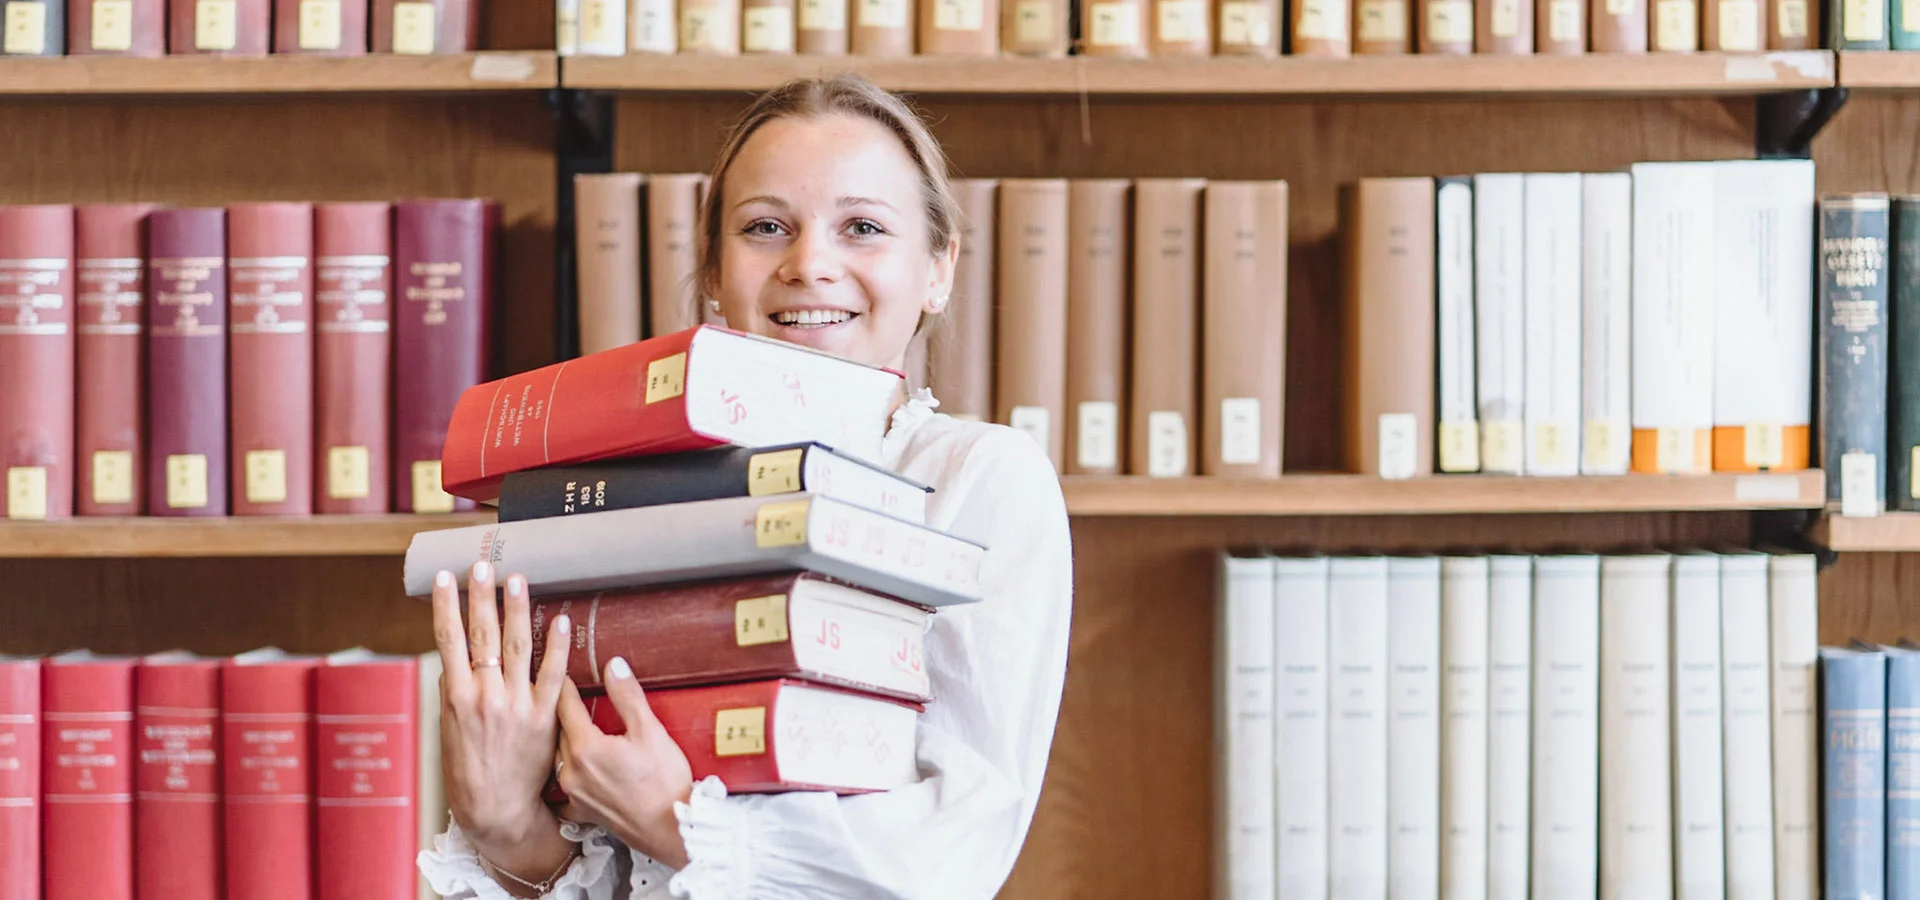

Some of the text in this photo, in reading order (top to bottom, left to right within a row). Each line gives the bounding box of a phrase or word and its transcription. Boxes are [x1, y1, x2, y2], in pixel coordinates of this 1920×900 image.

[507, 407, 517, 427] UND
[720, 389, 748, 425] JS
[494, 393, 512, 448] WIRTSCHAFT
[580, 486, 591, 506] 183
[594, 480, 606, 507] 2019
[493, 539, 506, 562] 1992
[576, 624, 586, 649] 1987
[816, 619, 841, 650] JS
